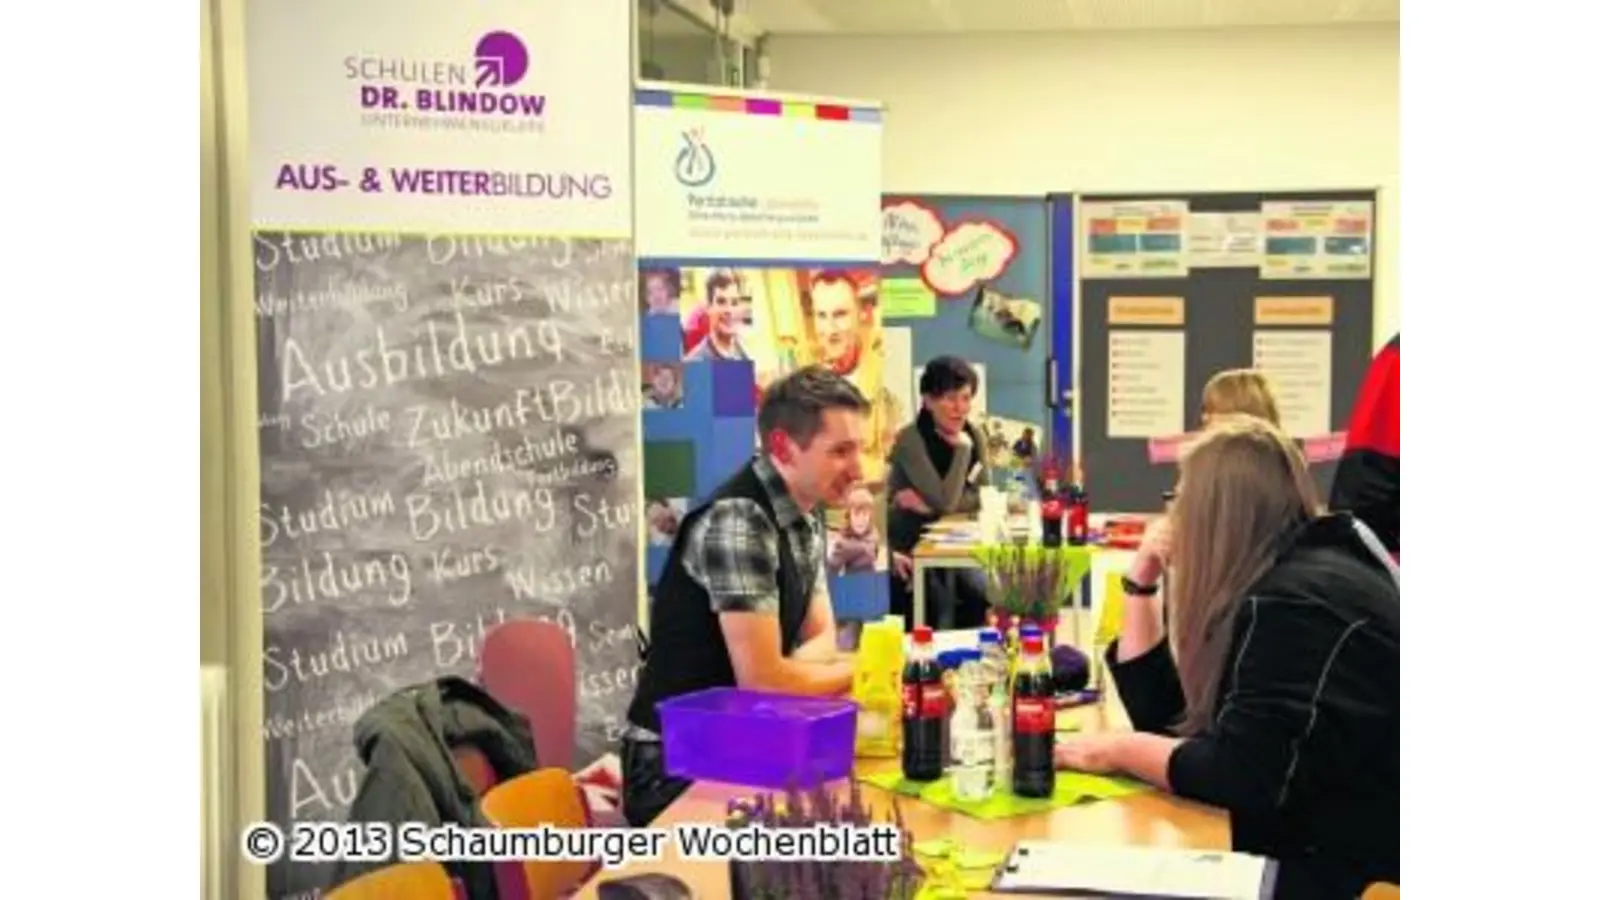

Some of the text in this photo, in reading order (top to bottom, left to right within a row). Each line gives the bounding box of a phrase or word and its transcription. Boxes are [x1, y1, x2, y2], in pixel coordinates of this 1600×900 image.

[344, 56, 467, 85] SCHULEN
[360, 85, 546, 117] DR. BLINDOW
[276, 163, 612, 199] AUS- & WEITERBILDUNG
[451, 276, 523, 306] Kurs
[281, 311, 563, 402] Ausbildung
[301, 404, 391, 449] Schule
[423, 427, 579, 486] Abendschule
[259, 489, 397, 546] Studium
[406, 480, 556, 541] Bildung
[258, 551, 413, 612] Bildung
[430, 544, 500, 584] Kurs
[505, 559, 613, 599] Wissen
[261, 631, 408, 691] Studium
